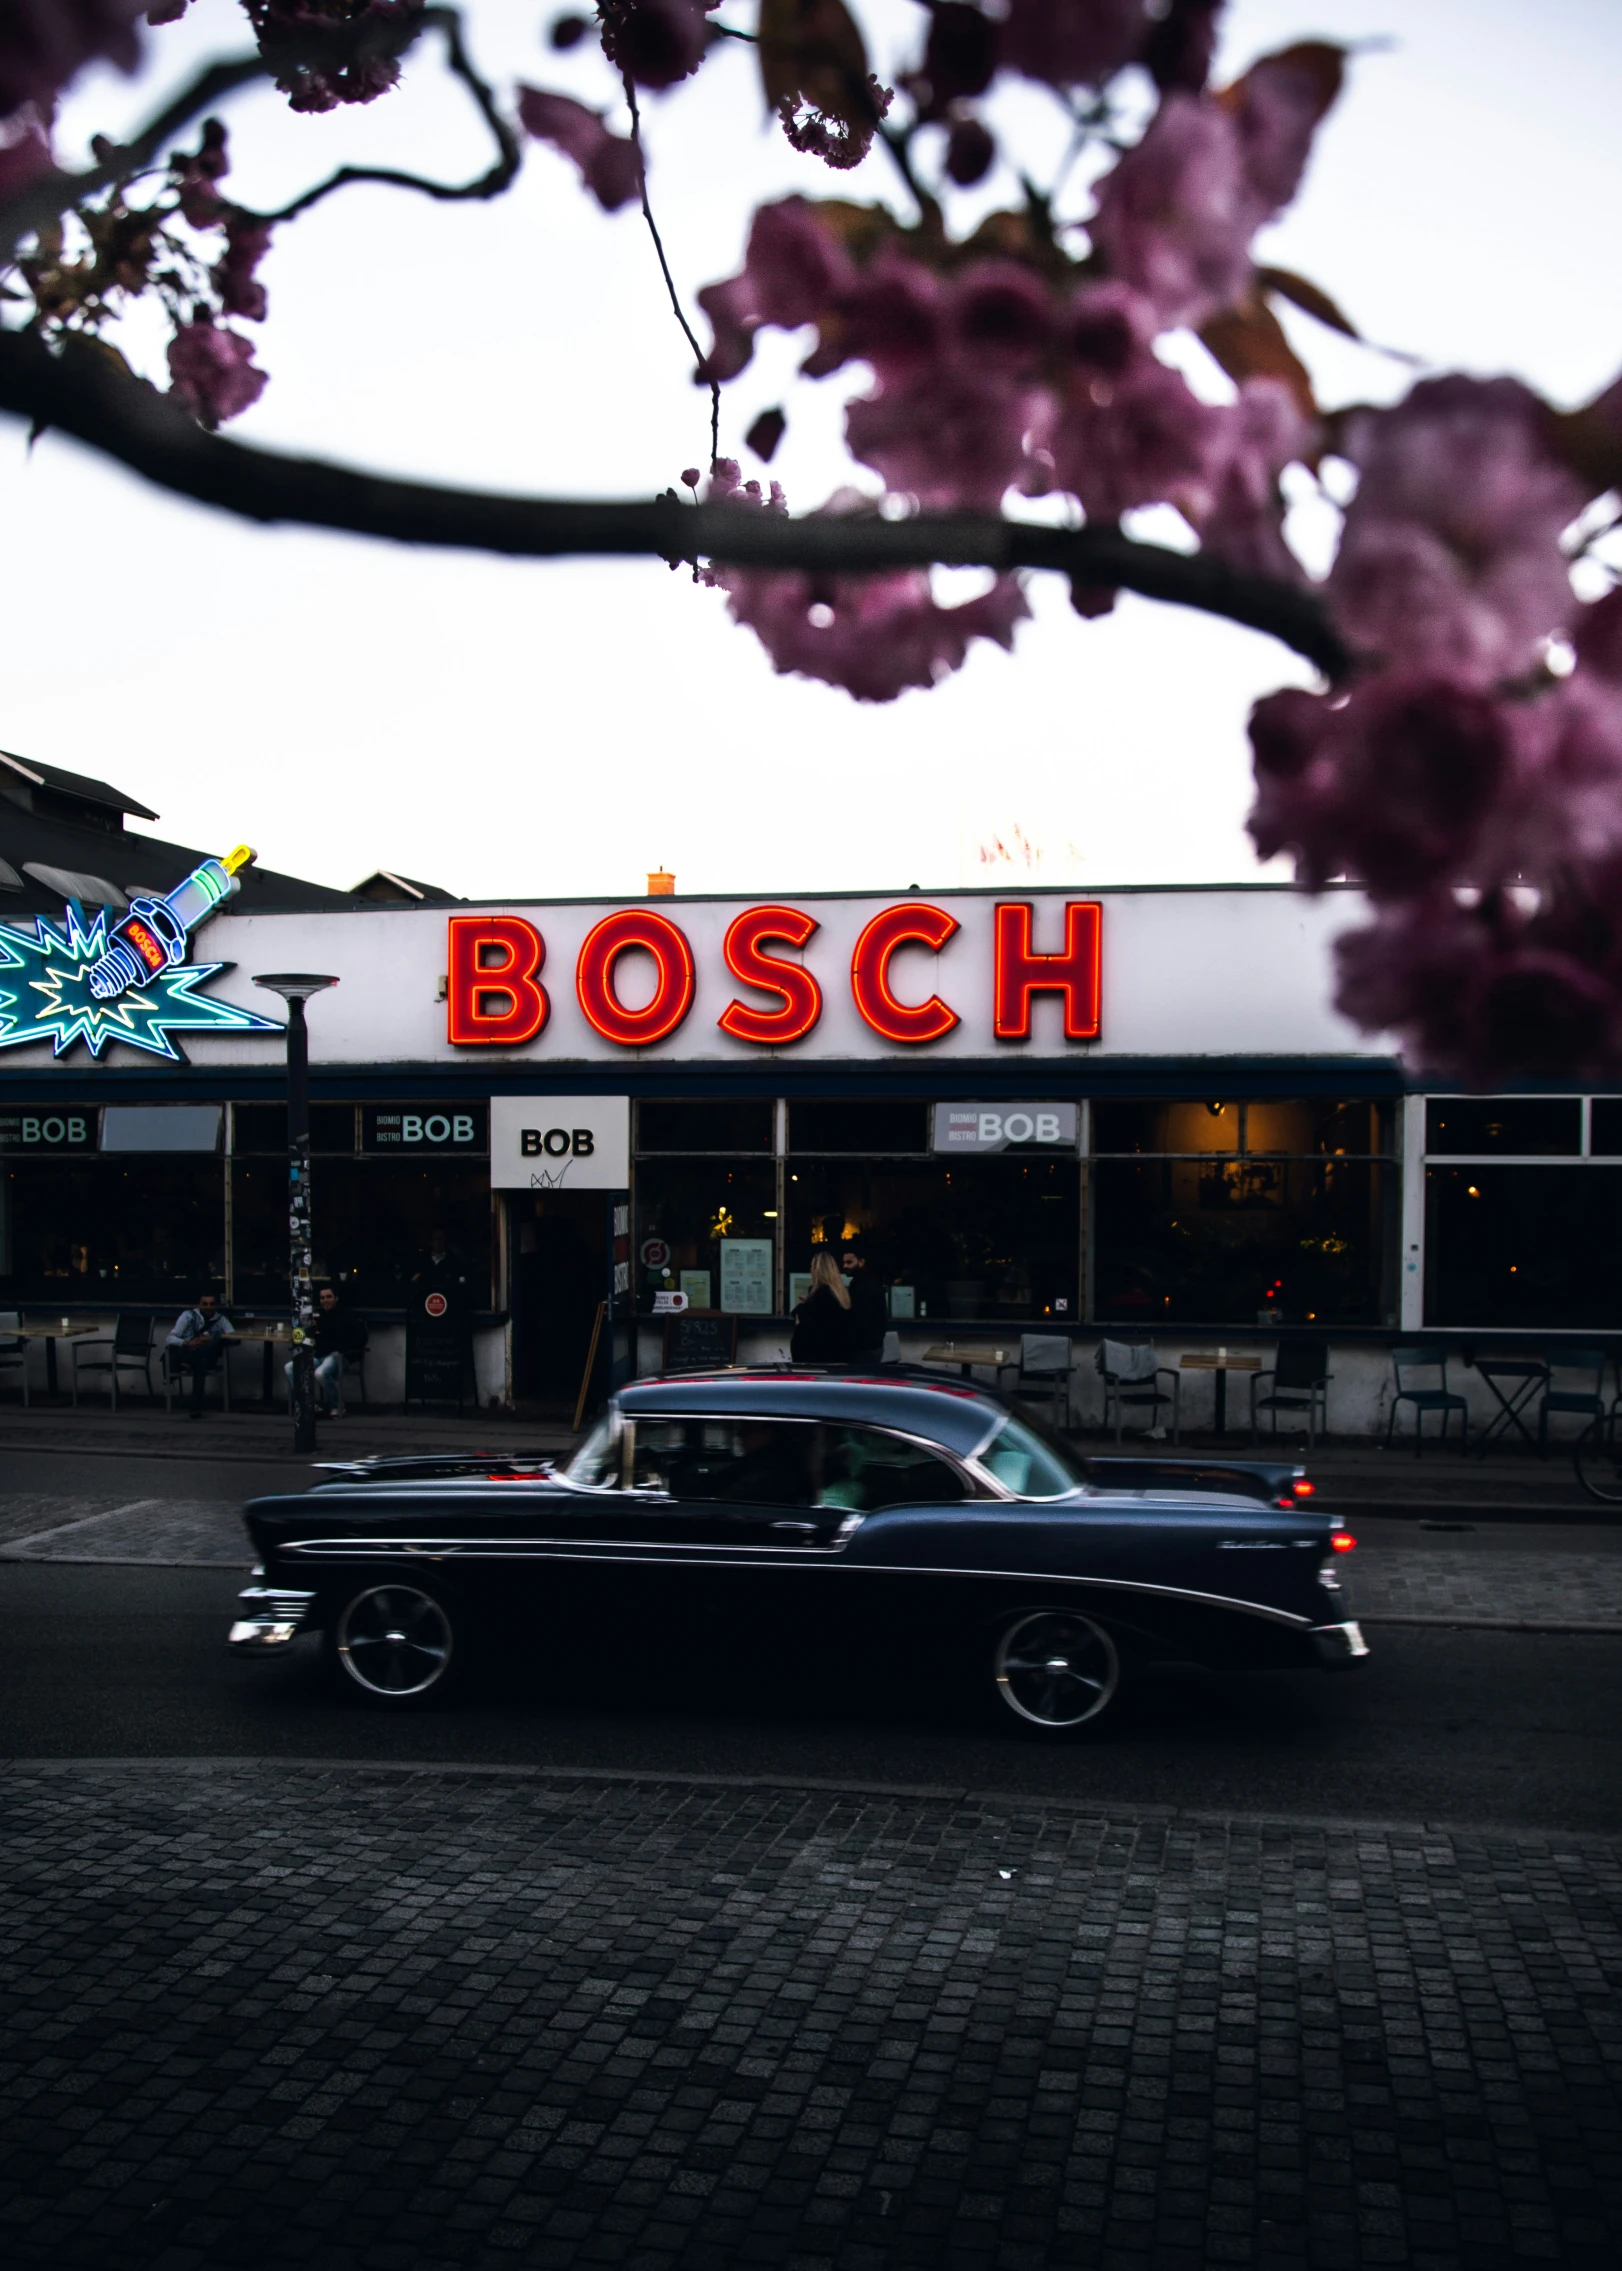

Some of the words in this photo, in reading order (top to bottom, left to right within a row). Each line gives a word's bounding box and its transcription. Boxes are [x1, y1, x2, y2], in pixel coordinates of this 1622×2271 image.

[128, 924, 162, 967] BOSCH
[449, 902, 1102, 1045] BOSCH
[22, 1116, 87, 1143] BOB
[376, 1115, 401, 1125] BIOMIO
[402, 1114, 475, 1142] BOB
[949, 1113, 977, 1124] BIOMIO
[979, 1113, 1061, 1142] BOB
[376, 1132, 401, 1142] BISTRO
[520, 1128, 595, 1157] BOB
[949, 1131, 977, 1141] BISTRO
